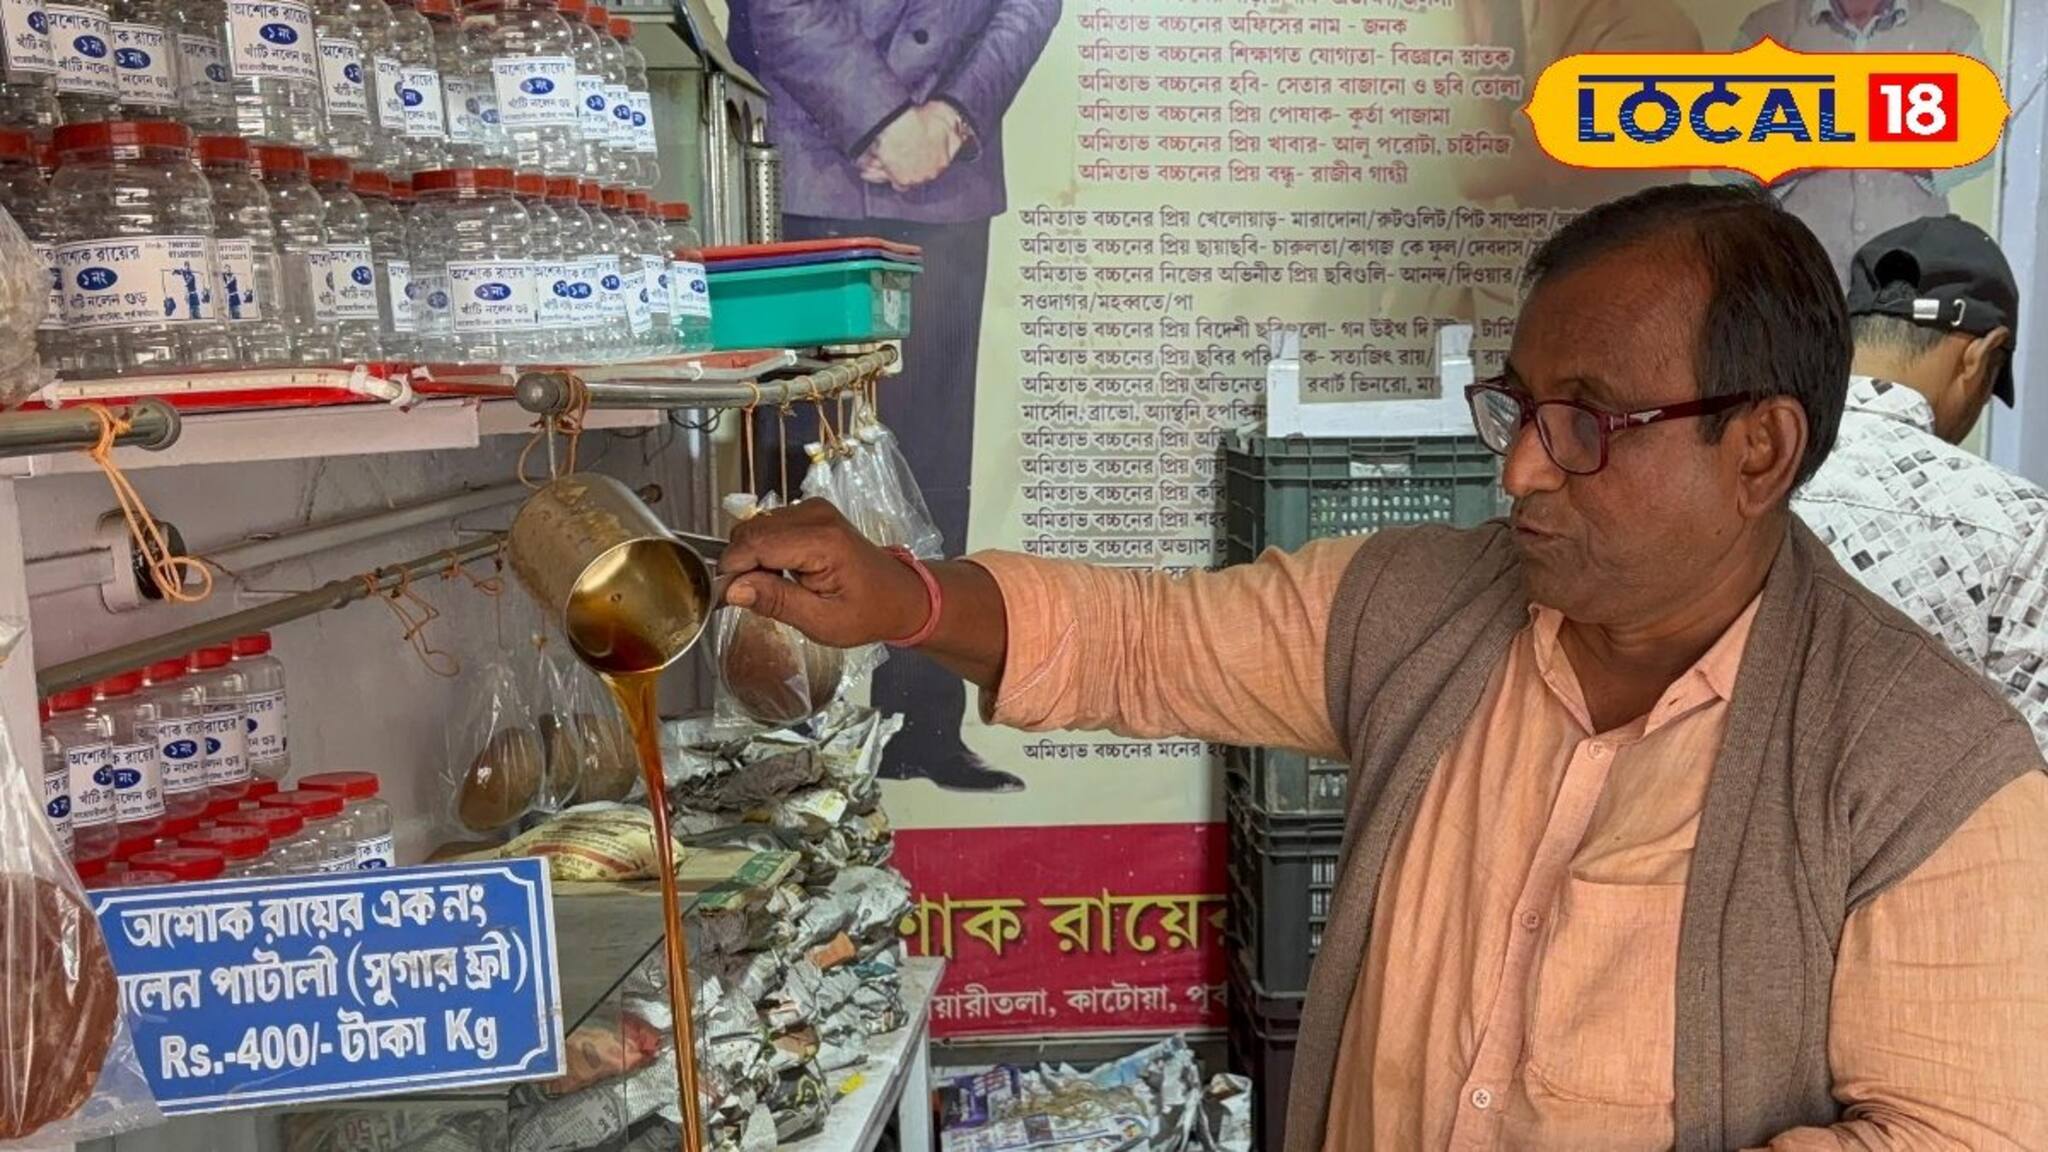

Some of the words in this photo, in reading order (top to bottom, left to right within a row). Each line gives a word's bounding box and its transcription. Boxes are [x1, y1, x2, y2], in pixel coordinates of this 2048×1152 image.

[232, 3, 280, 18] অশোক
[1078, 8, 1150, 32] অমিতাভ
[1156, 16, 1222, 33] বচ্চনের
[1228, 10, 1303, 34] অফিসের
[1309, 18, 1340, 34] নাম
[1362, 18, 1408, 35] জনক
[1078, 38, 1150, 62] অমিতাভ
[1156, 46, 1222, 63] বচ্চনের
[1229, 39, 1302, 64] শিক্ষাগত
[1390, 41, 1453, 66] বিজ্ঞানে
[1078, 68, 1150, 92] অমিতাভ
[1156, 76, 1222, 93] বচ্চনের
[1277, 77, 1332, 94] সেতার
[1337, 78, 1405, 95] বাজানো
[1413, 79, 1426, 94] ও
[1433, 72, 1463, 97] ছবি
[1471, 78, 1521, 97] তোলা
[1078, 98, 1150, 122] অমিতাভ
[1156, 106, 1222, 123] বচ্চনের
[1228, 99, 1261, 123] প্রিয়
[1347, 103, 1383, 129] কুর্তা
[1390, 107, 1450, 125] পাজামা
[1078, 128, 1150, 152] অমিতাভ
[1156, 136, 1222, 153] বচ্চনের
[1228, 129, 1260, 152] প্রিয়
[1332, 137, 1370, 158] আলু
[1446, 131, 1511, 155] চাইনিজ
[1078, 158, 1150, 182] অমিতাভ
[1156, 166, 1222, 183] বচ্চনের
[1228, 159, 1260, 182] প্রিয়
[1310, 160, 1362, 182] রাজীব
[1020, 205, 1088, 229] অমিতাভ
[1092, 212, 1154, 228] বচ্চনের
[1159, 205, 1190, 227] প্রিয়
[1020, 232, 1088, 256] অমিতাভ
[1092, 239, 1154, 255] বচ্চনের
[1159, 233, 1190, 256] প্রিয়
[1401, 240, 1424, 256] কে
[91, 270, 109, 285] নং
[1020, 260, 1088, 284] অমিতাভ
[1092, 267, 1154, 283] বচ্চনের
[1159, 261, 1212, 283] নিজের
[1217, 261, 1284, 284] অভিনীত
[1288, 261, 1318, 283] প্রিয়
[1020, 315, 1088, 339] অমিতাভ
[1092, 322, 1154, 338] বচ্চনের
[1159, 316, 1190, 338] প্রিয়
[1195, 316, 1250, 339] বিদেশী
[1341, 321, 1364, 338] গন
[1369, 318, 1407, 340] উইথ
[1413, 316, 1429, 338] দি
[1020, 343, 1088, 367] অমিতাভ
[1092, 350, 1154, 366] বচ্চনের
[1159, 344, 1190, 366] প্রিয়
[1195, 344, 1236, 367] ছবির
[1329, 343, 1393, 367] সত্যজিৎ
[1020, 371, 1088, 395] অমিতাভ
[1092, 378, 1154, 394] বচ্চনের
[1159, 372, 1190, 394] প্রিয়
[1306, 371, 1344, 394] রবার্ট
[1022, 426, 1088, 448] অমিতাভ
[1092, 432, 1154, 448] বচ্চনের
[1159, 426, 1190, 448] প্রিয়
[1022, 453, 1088, 475] অমিতাভ
[1092, 459, 1154, 475] বচ্চনের
[1159, 453, 1190, 475] প্রিয়
[1022, 480, 1088, 502] অমিতাভ
[1092, 486, 1154, 502] বচ্চনের
[1159, 480, 1190, 502] প্রিয়
[1022, 507, 1088, 529] অমিতাভ
[1092, 513, 1154, 529] বচ্চনের
[1159, 507, 1190, 529] প্রিয়
[1092, 539, 1154, 556] বচ্চনের
[1022, 738, 1088, 759] অমিতাভ
[1093, 743, 1152, 759] বচ্চনের
[1158, 741, 1200, 758] মনের
[121, 900, 254, 949] অশোক
[258, 892, 364, 944] রায়ের
[371, 886, 436, 928] এক
[441, 884, 488, 927] নং
[210, 945, 339, 1004] পাটালী
[346, 940, 457, 1006] (সুগার
[463, 929, 529, 993] ফ্রী)
[1063, 980, 1176, 1014] কাটোয়া,
[160, 1021, 333, 1079] Rs.-400/-
[337, 1009, 427, 1062] টাকা
[446, 1007, 497, 1060] Kg
